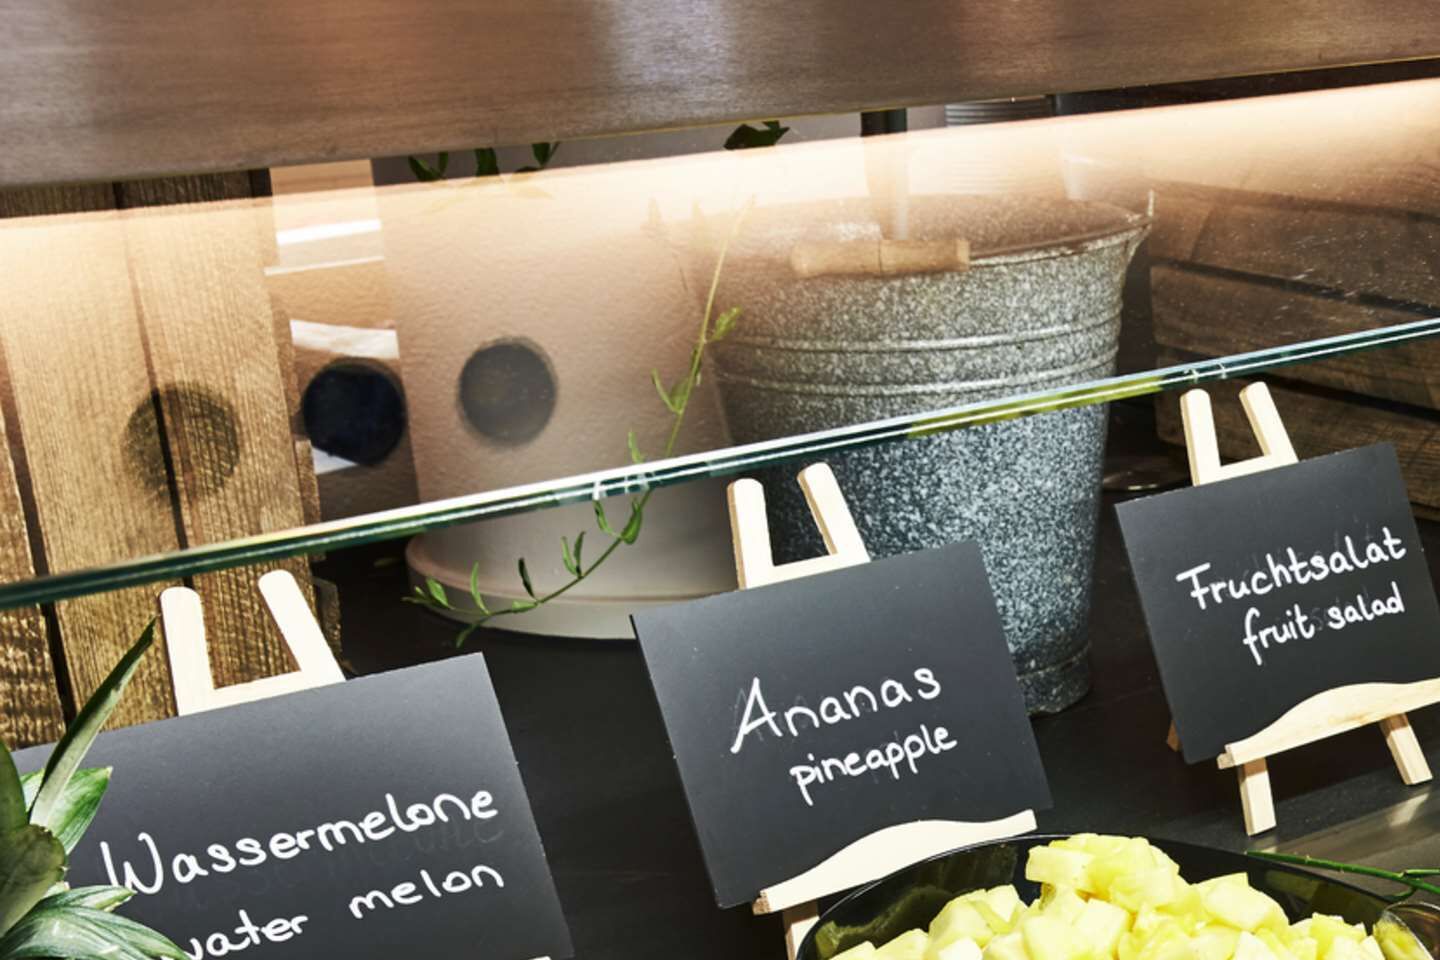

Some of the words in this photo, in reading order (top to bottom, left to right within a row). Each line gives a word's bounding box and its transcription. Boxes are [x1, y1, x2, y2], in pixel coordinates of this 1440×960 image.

[1176, 527, 1406, 609] Fruchtsalat
[1243, 604, 1315, 665] fruit
[1328, 581, 1404, 629] salad
[731, 667, 941, 753] Ananas
[790, 724, 957, 805] pineapple
[100, 790, 498, 895] Wassermelone
[349, 864, 504, 918] melon
